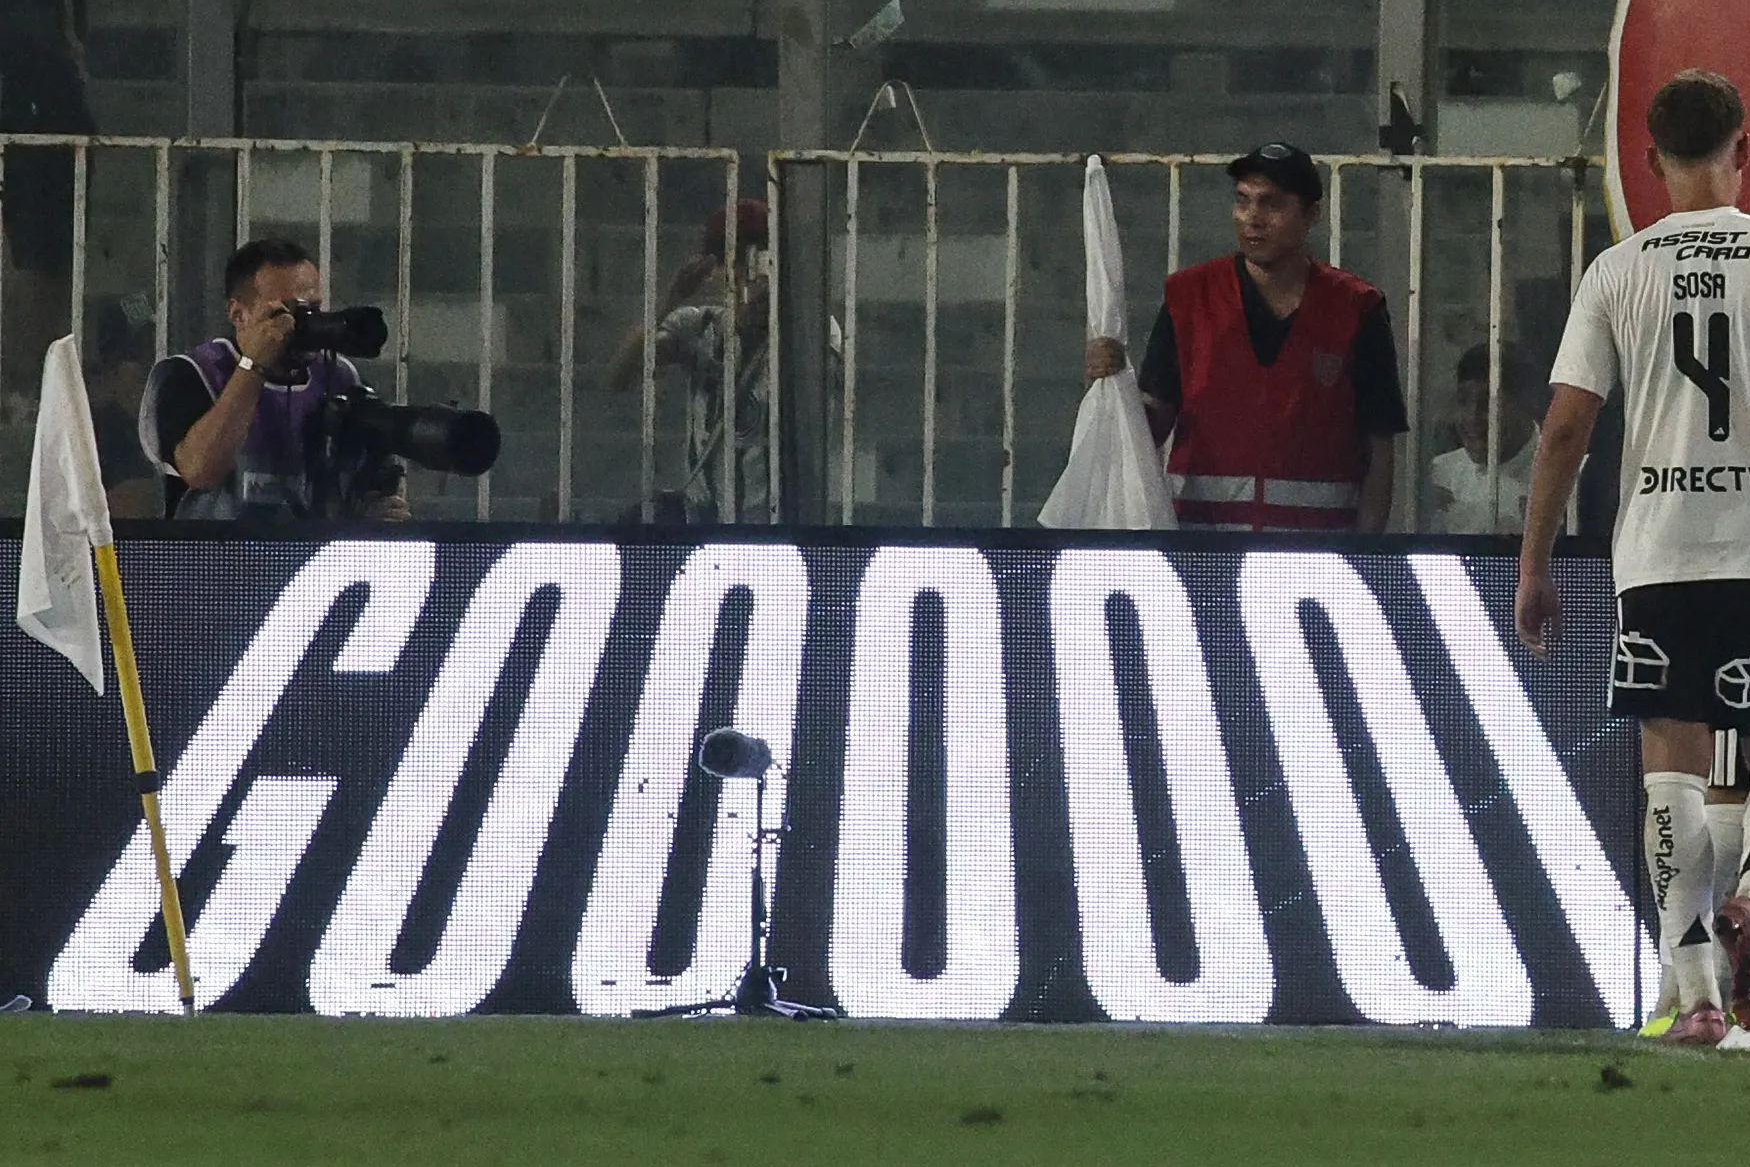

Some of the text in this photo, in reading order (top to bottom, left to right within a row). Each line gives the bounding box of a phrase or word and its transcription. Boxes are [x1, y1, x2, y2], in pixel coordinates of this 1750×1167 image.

[1641, 231, 1749, 252] ASSIST
[1673, 271, 1726, 300] SOSA
[1673, 312, 1730, 442] 4
